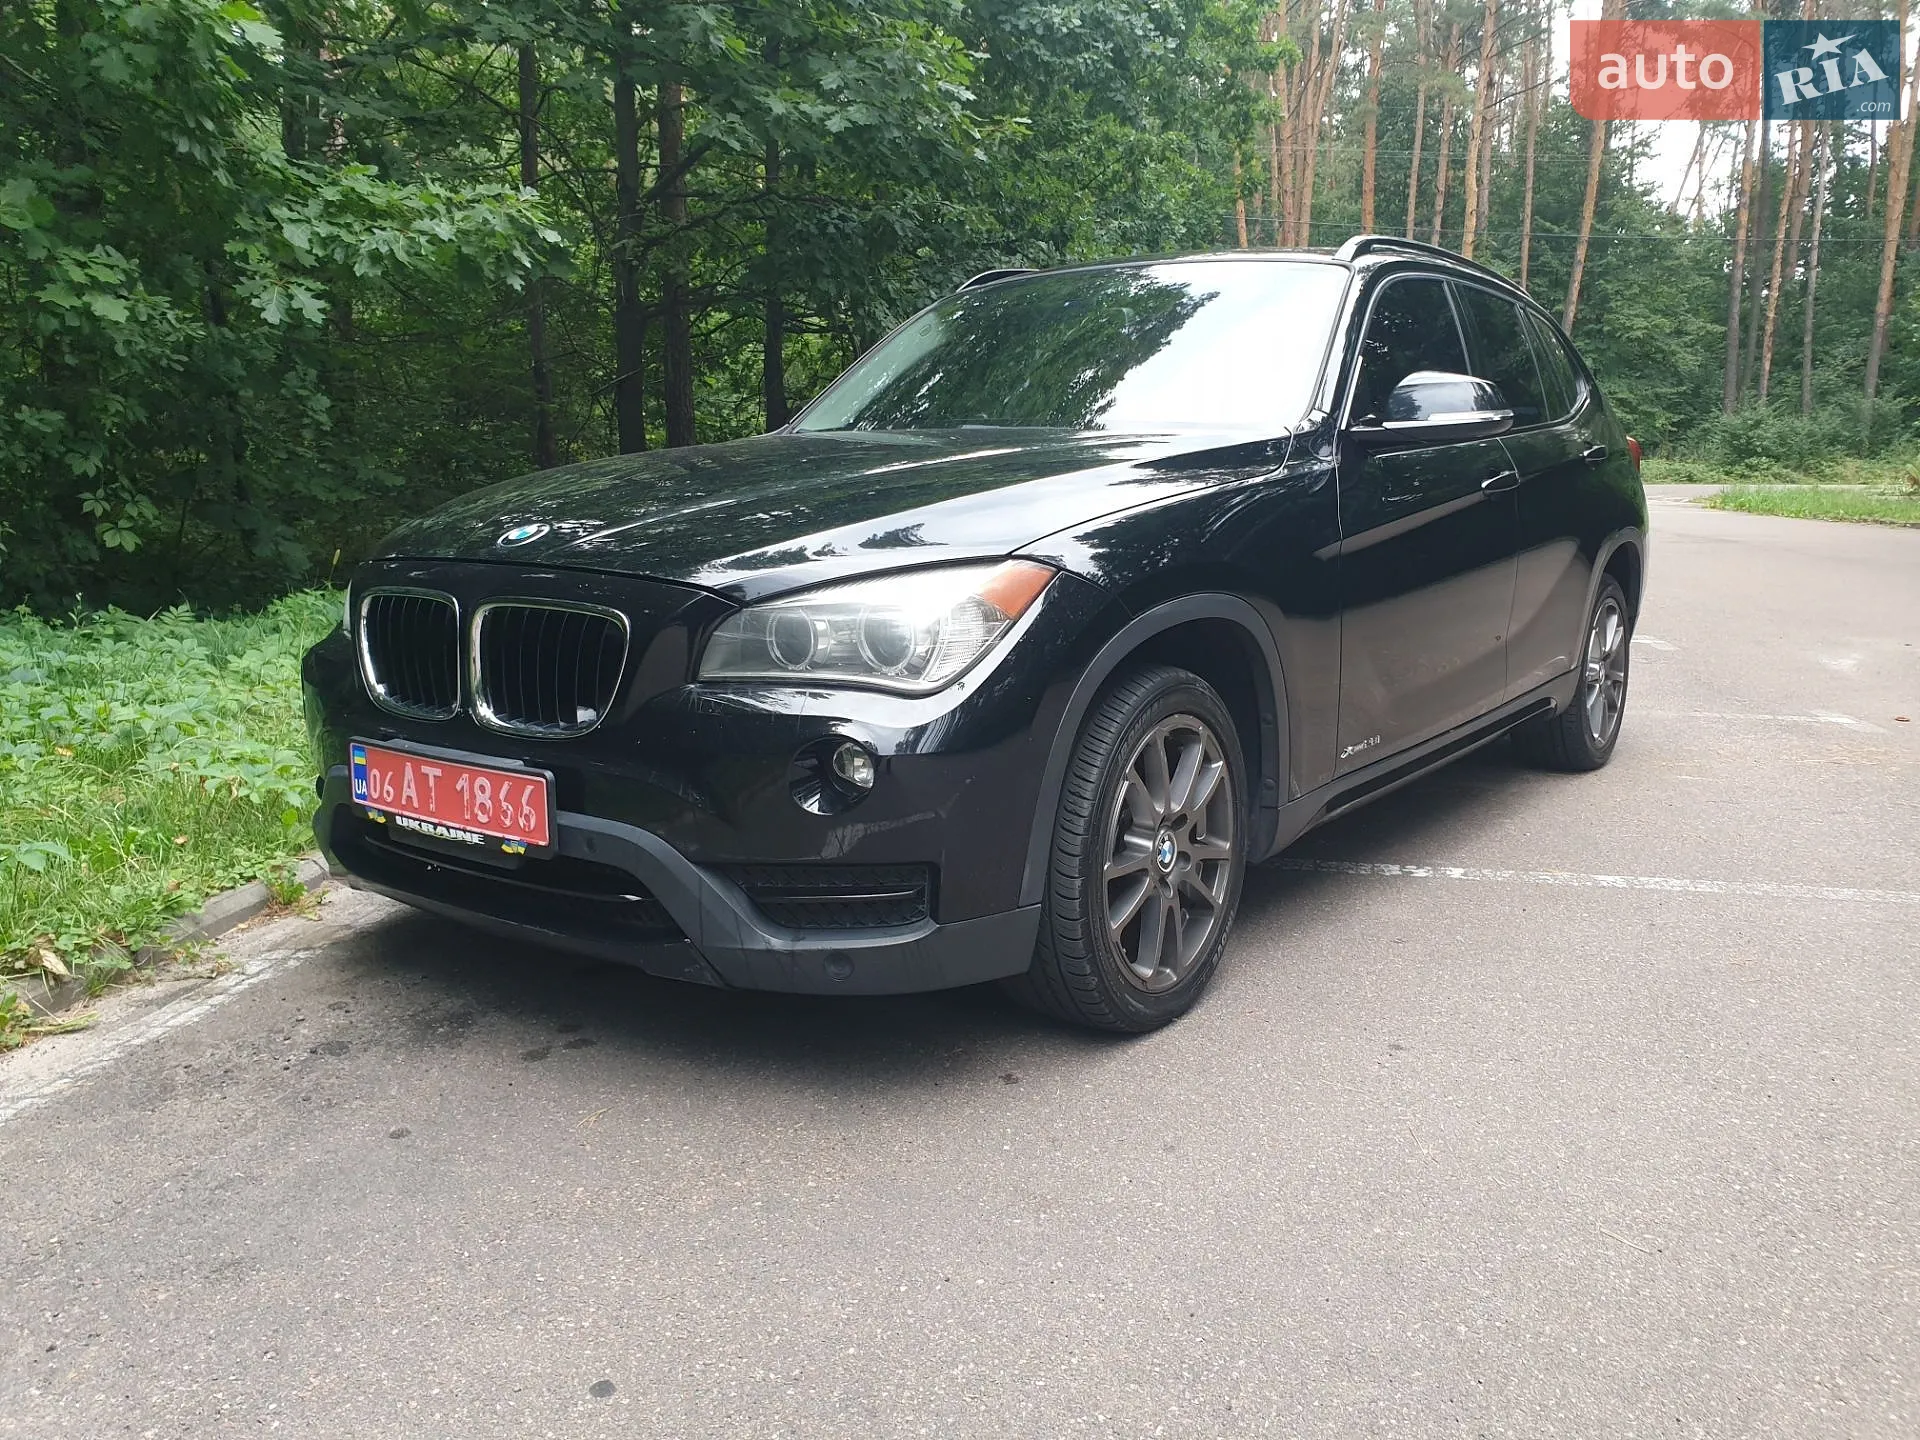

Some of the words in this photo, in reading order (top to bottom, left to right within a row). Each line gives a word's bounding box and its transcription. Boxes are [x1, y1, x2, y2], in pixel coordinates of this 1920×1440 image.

[354, 778, 368, 796] UA
[456, 774, 536, 832] 1866
[395, 815, 485, 845] UKRAINE
